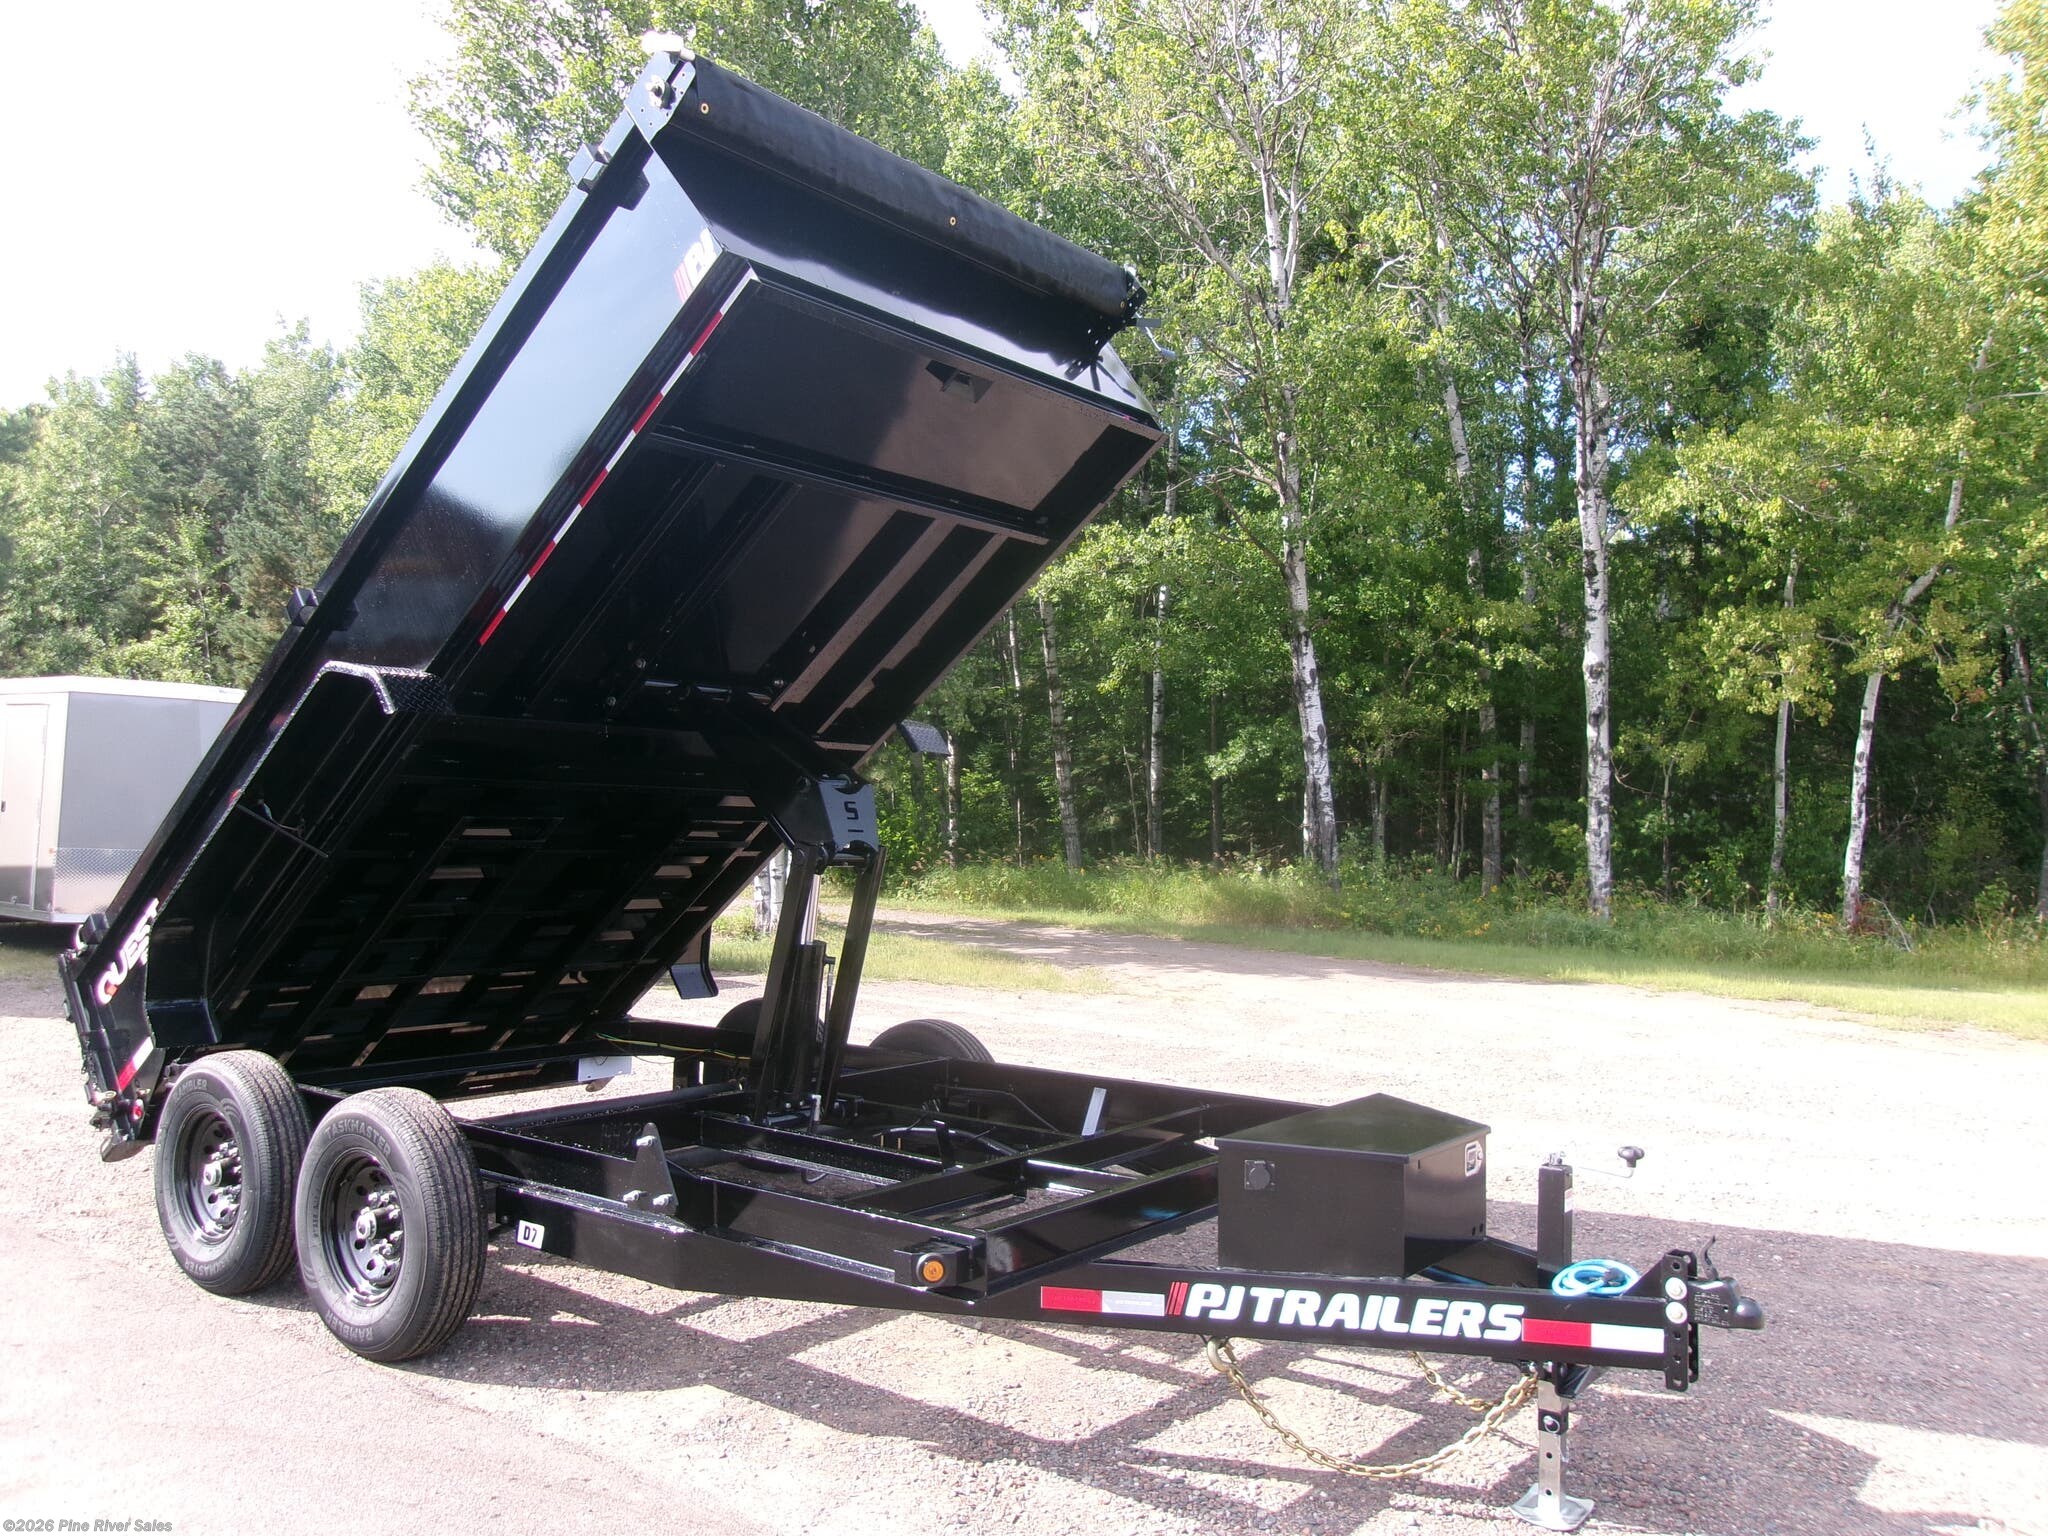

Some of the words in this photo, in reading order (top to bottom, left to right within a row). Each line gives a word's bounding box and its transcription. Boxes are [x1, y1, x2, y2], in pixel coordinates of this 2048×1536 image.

[325, 1118, 392, 1158] TASKMASTER
[523, 1225, 538, 1243] D7
[1185, 1283, 1246, 1321] PJ
[1250, 1286, 1525, 1342] TRAILERS
